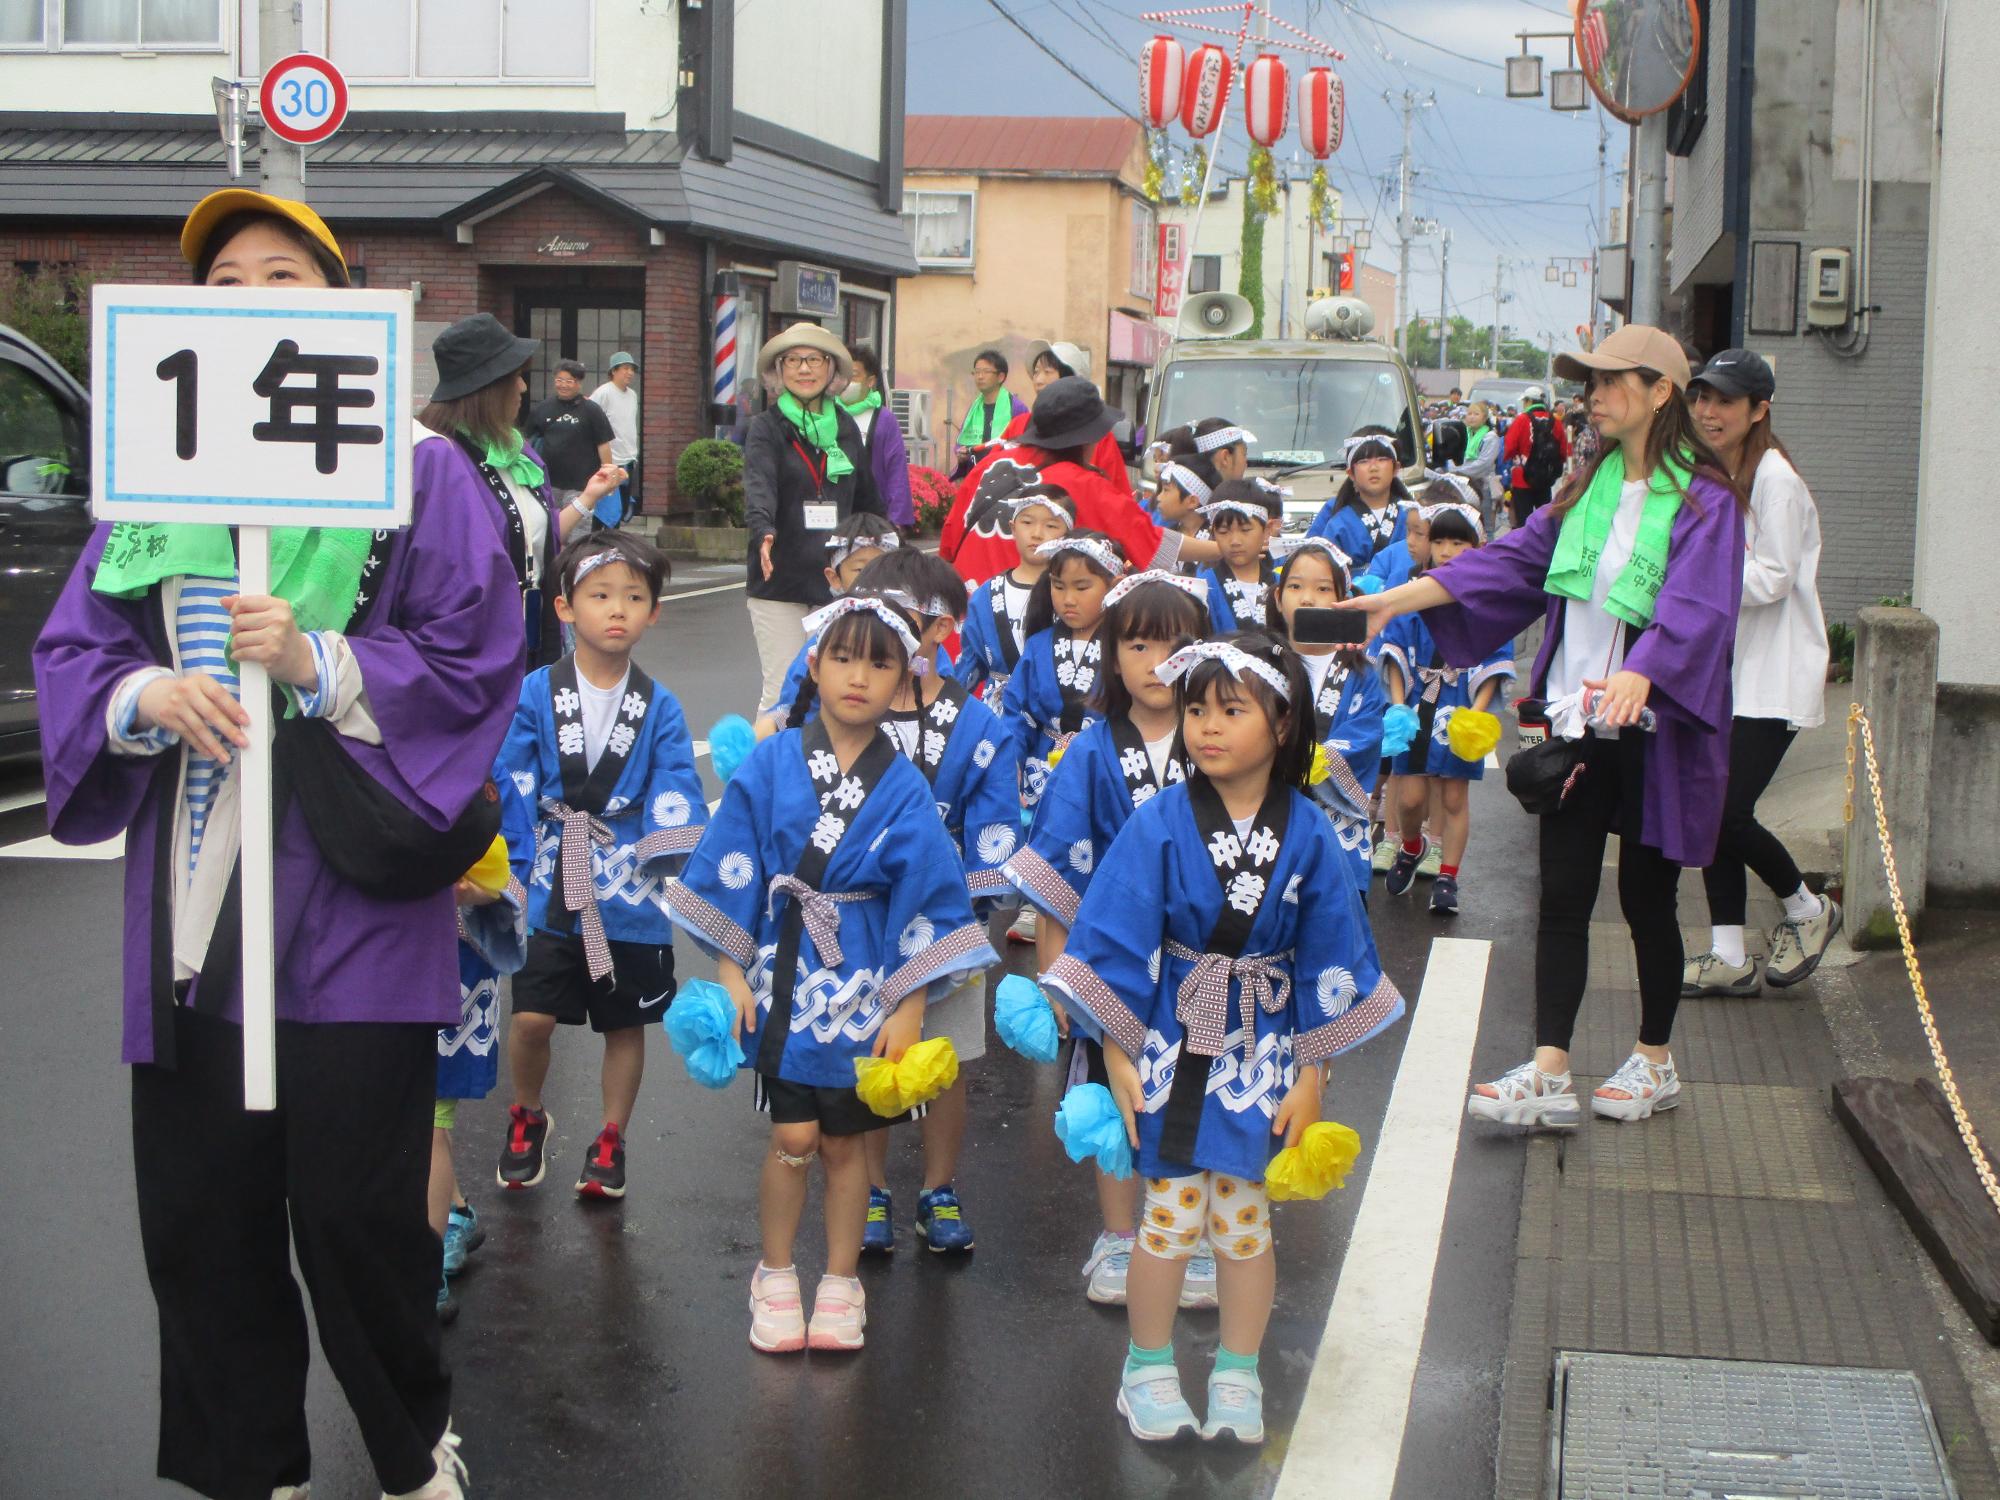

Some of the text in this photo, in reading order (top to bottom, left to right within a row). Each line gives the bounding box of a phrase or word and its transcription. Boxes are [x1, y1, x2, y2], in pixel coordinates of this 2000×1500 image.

[281, 80, 328, 117] 30
[156, 339, 384, 475] 1年
[554, 687, 584, 756] 中若
[608, 691, 647, 758] 中若
[810, 775, 866, 855] 中若
[1227, 825, 1280, 916] 中若
